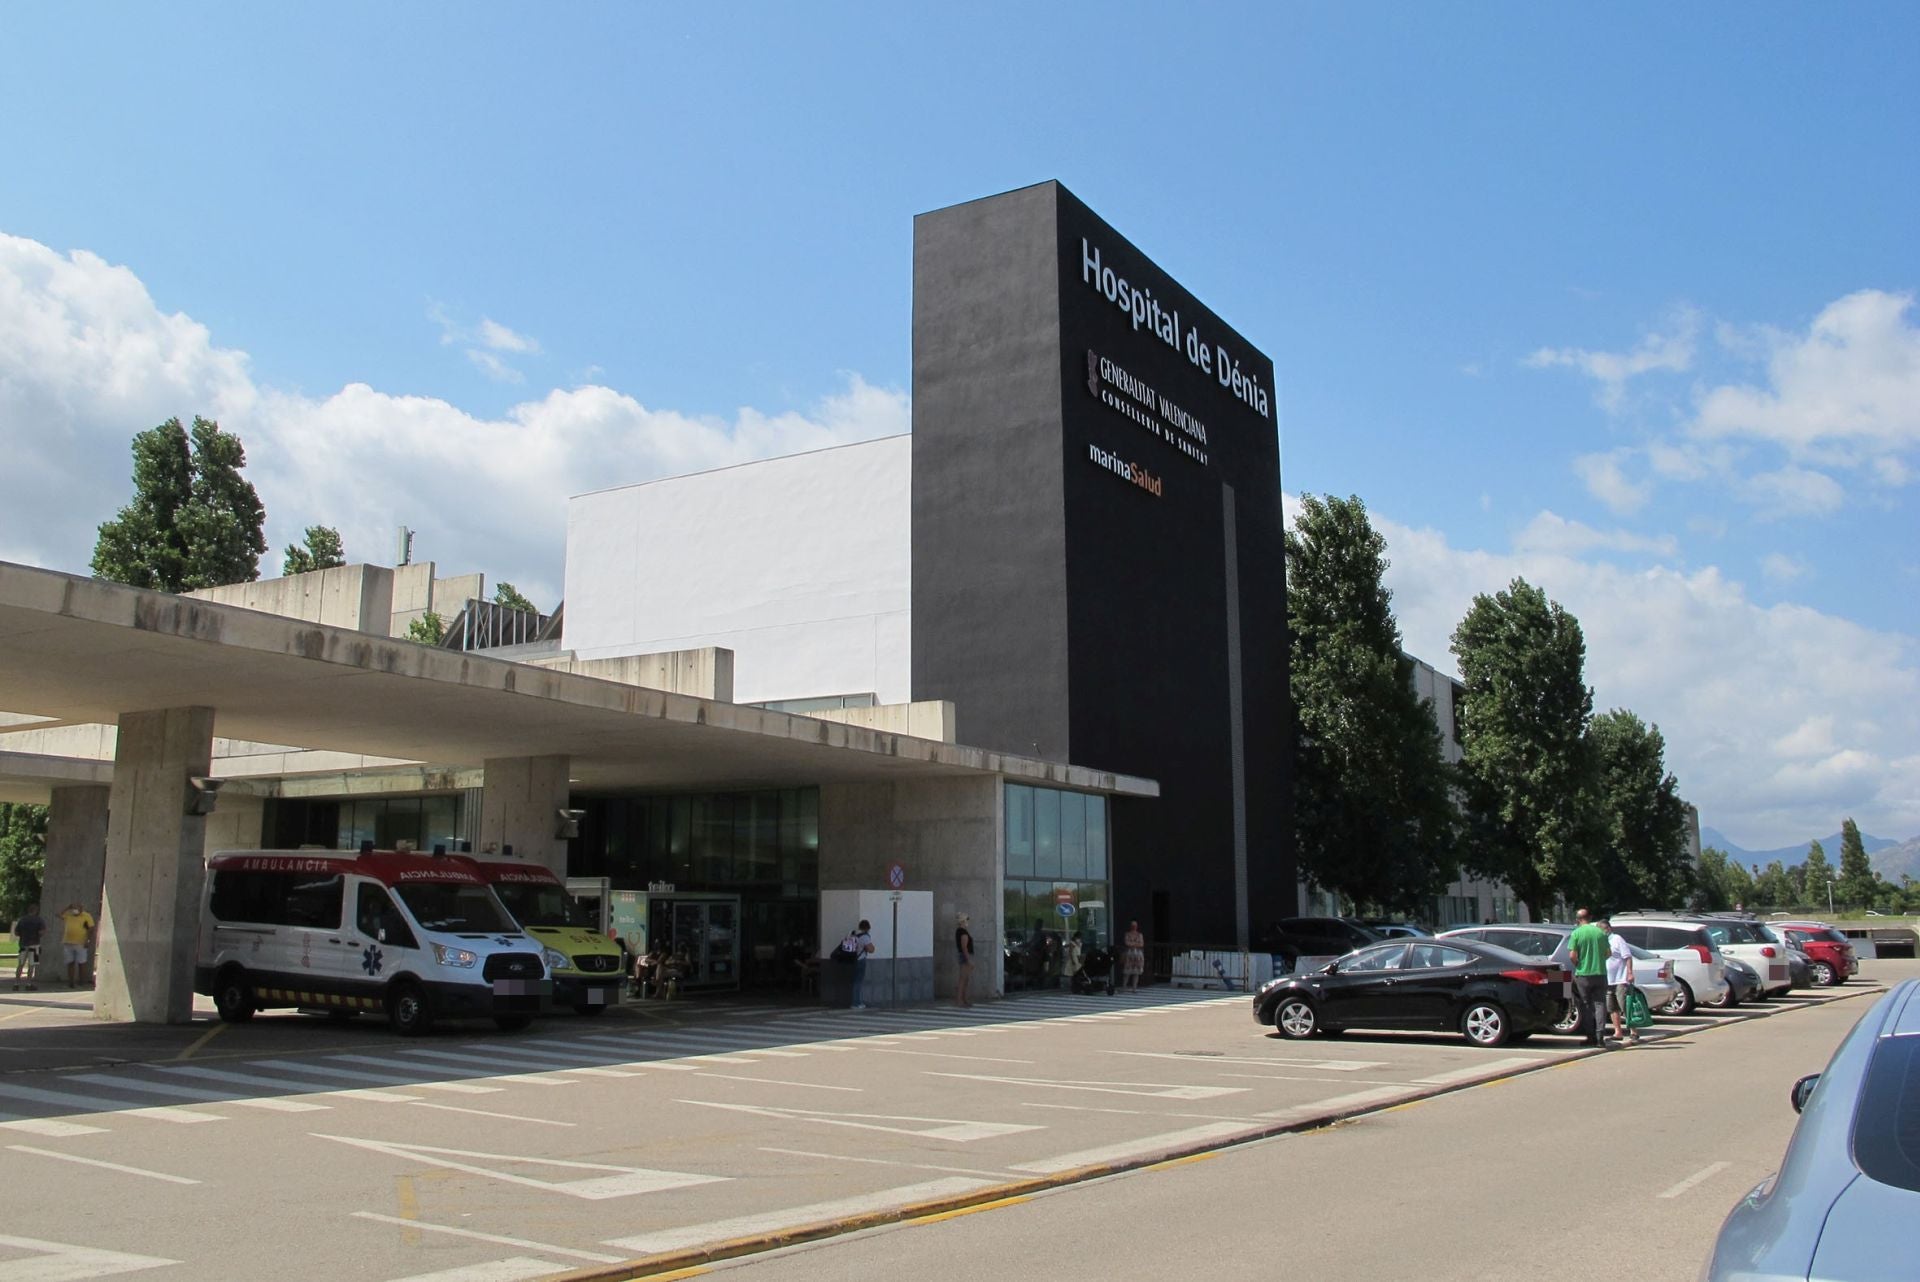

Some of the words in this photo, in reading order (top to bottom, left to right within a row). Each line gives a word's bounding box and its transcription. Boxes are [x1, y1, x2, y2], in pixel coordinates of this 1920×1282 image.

[1082, 237, 1180, 352] Hospital
[1186, 327, 1211, 374] de
[1217, 345, 1269, 418] Dénia
[1100, 357, 1156, 410] GENERALITAT
[1159, 395, 1207, 445] VALENCIANA
[1102, 390, 1161, 436] CONSELLERIA
[1165, 429, 1175, 444] DE
[1178, 437, 1208, 466] SANITAT
[1089, 444, 1162, 497] marinaSalud
[243, 859, 329, 871] AMBULANCIA
